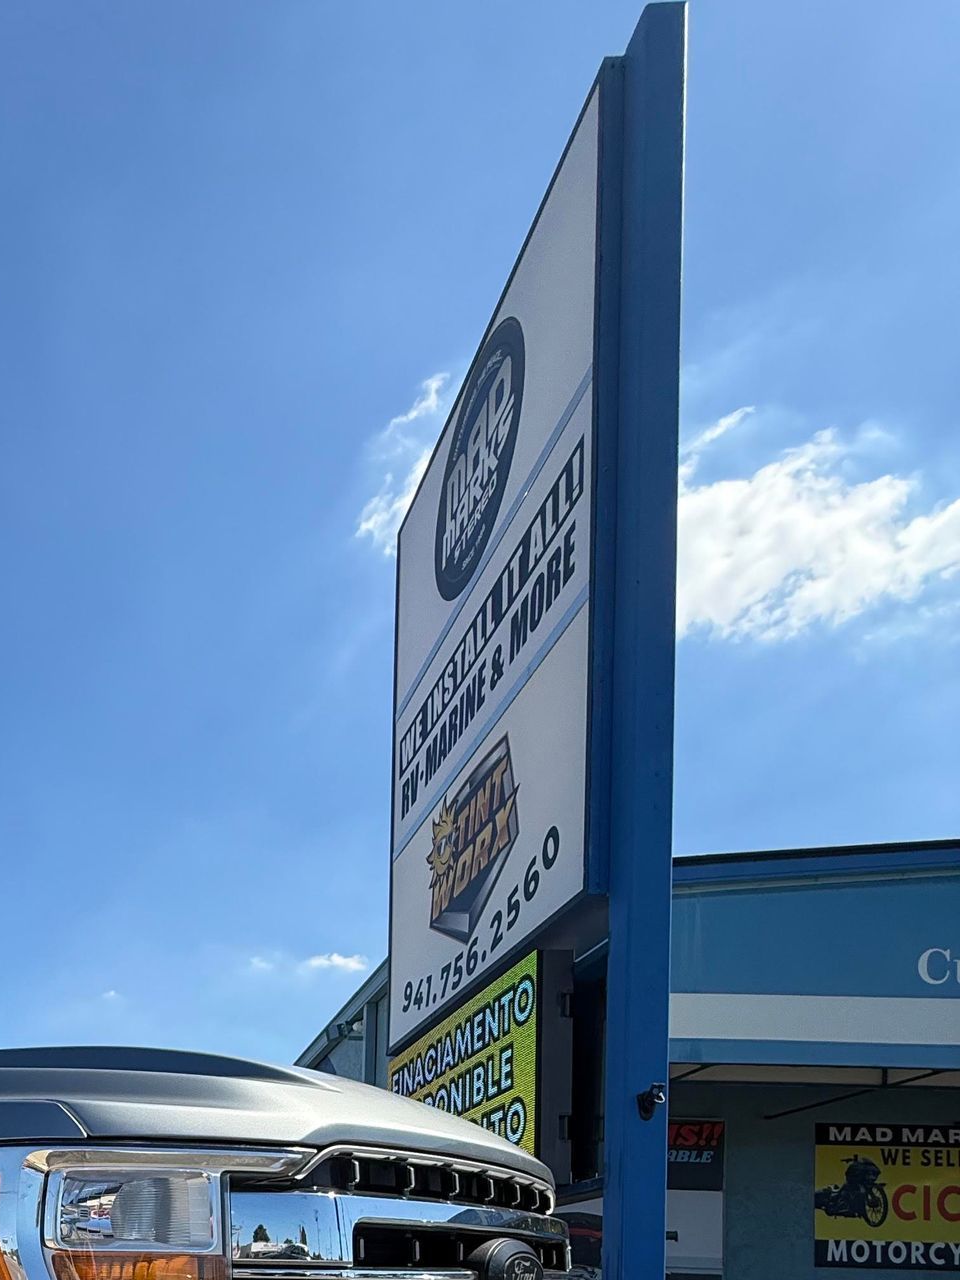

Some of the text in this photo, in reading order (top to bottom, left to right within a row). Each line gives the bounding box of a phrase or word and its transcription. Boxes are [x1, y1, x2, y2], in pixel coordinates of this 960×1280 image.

[441, 392, 515, 572] MARKS
[445, 354, 513, 520] MAD
[453, 470, 498, 565] STEREO
[401, 446, 582, 770] WE INSTALL IT ALL!
[490, 643, 505, 691] &
[509, 518, 577, 666] MORE
[432, 784, 518, 921] WORX
[457, 755, 510, 852] TINT
[401, 825, 560, 1013] 941.756.2560
[391, 977, 535, 1096] FINACIAMENTO
[424, 1048, 512, 1116] ONIBLE
[828, 1126, 893, 1142] MAD
[880, 1148, 960, 1167] WE SEL
